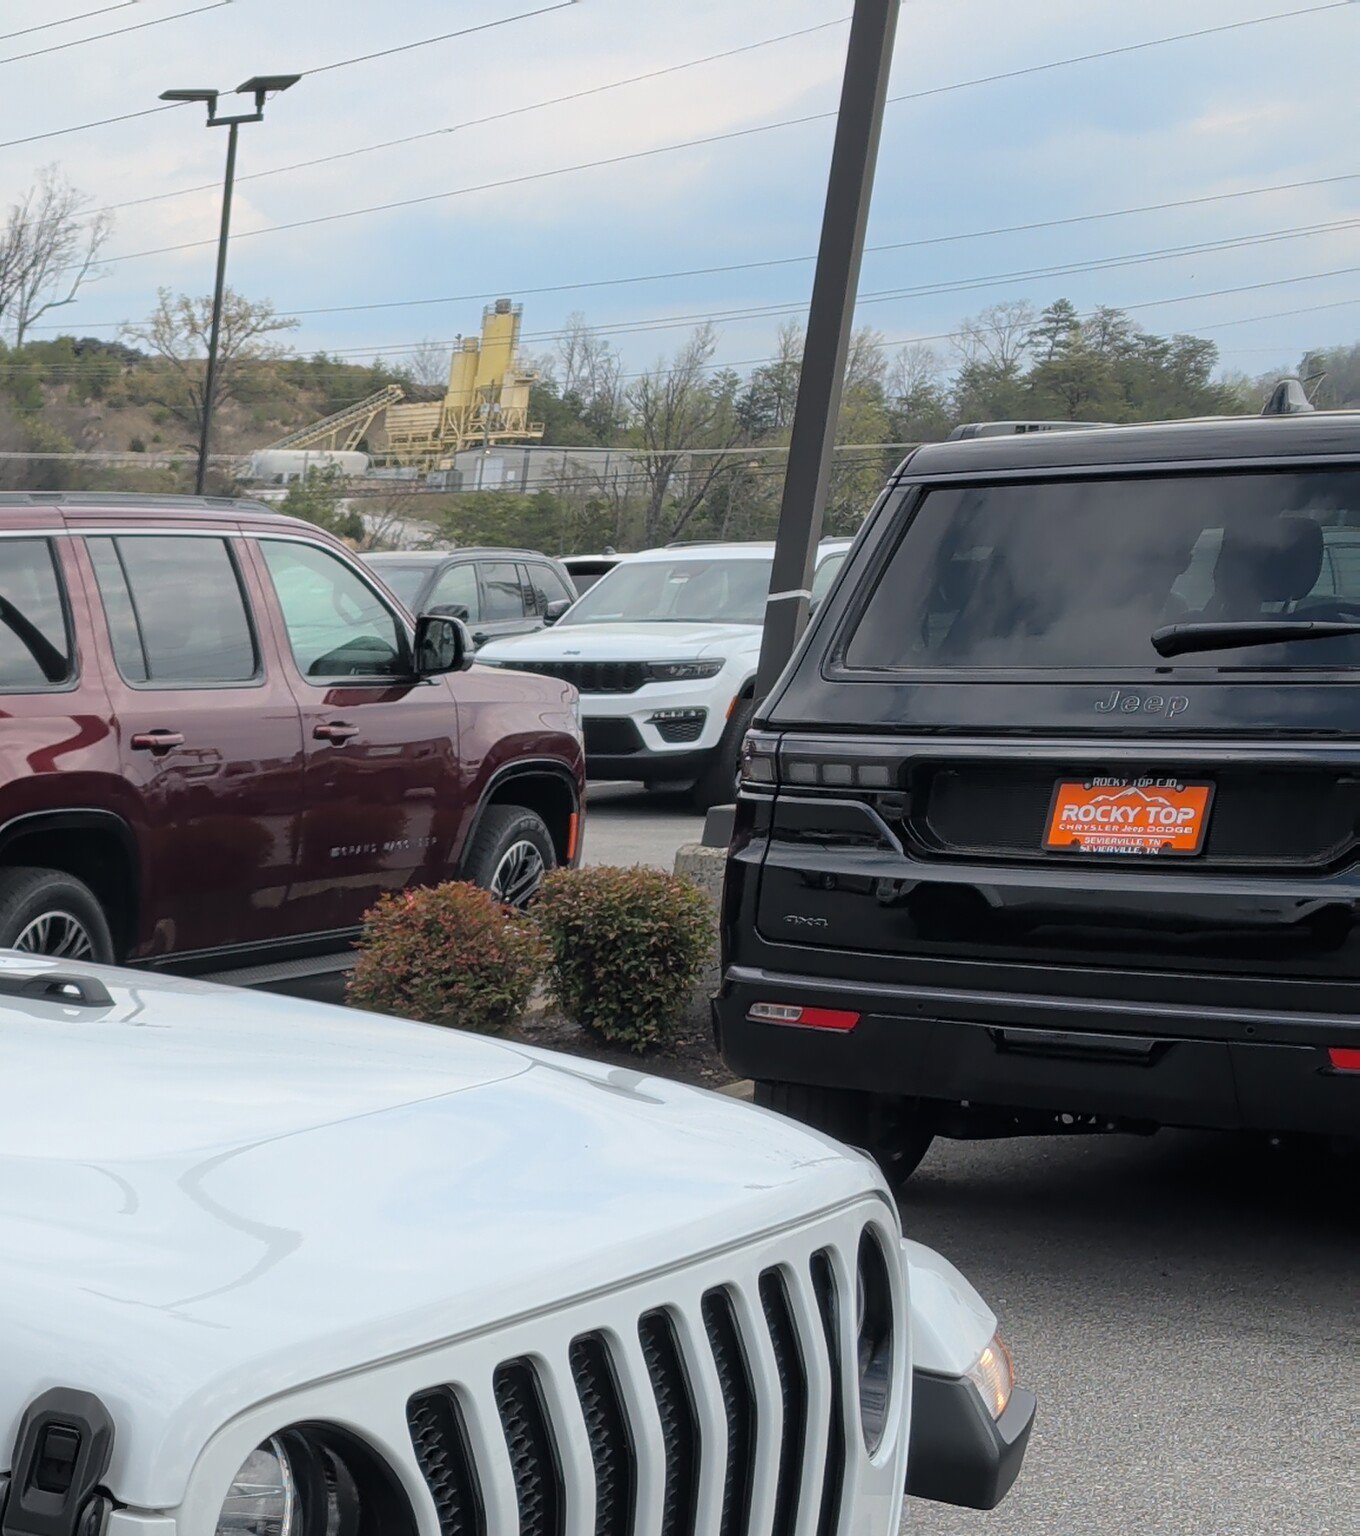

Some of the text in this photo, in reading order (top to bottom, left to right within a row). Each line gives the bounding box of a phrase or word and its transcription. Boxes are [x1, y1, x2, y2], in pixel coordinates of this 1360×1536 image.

[1094, 690, 1189, 719] Jeep
[1092, 777, 1128, 787] ROCKY
[1062, 804, 1196, 825] ROCKY TOP
[1058, 823, 1194, 834] CHRYSLER Jeep DODGE
[1148, 838, 1162, 846] TN
[1146, 847, 1159, 855] TN
